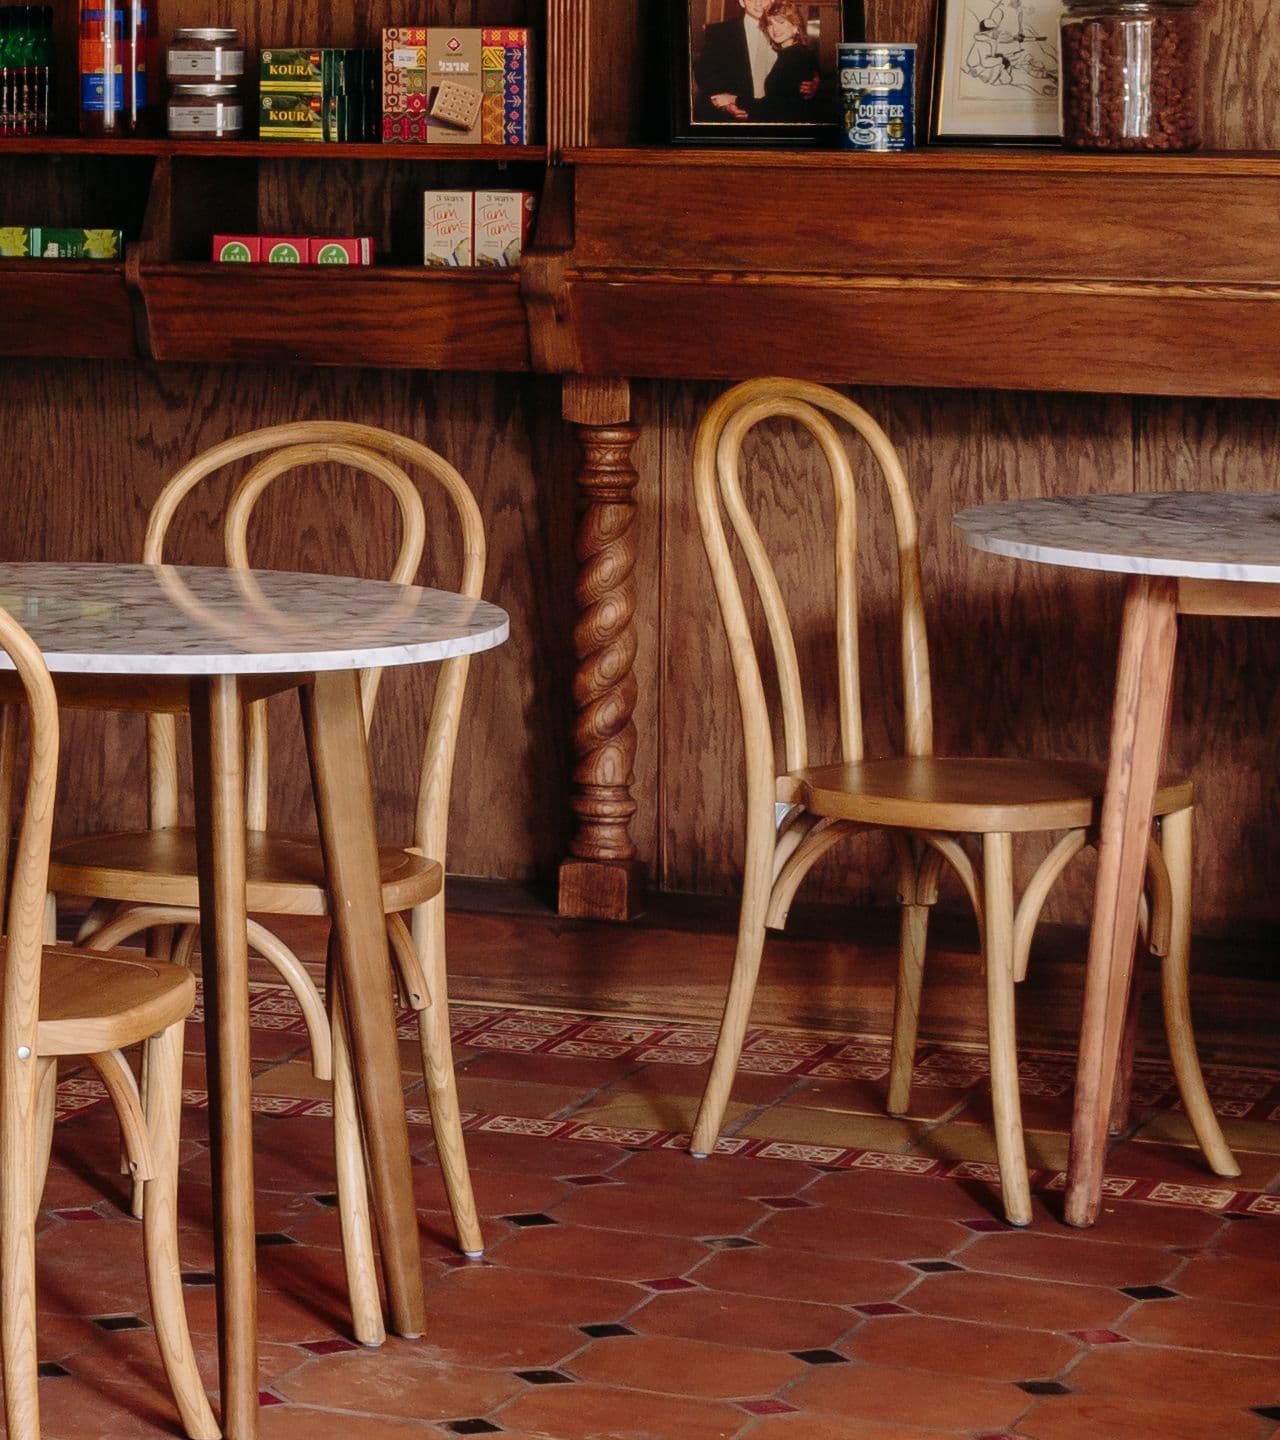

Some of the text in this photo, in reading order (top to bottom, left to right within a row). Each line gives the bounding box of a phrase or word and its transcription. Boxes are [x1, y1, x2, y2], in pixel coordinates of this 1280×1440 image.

[269, 64, 313, 76] KOURA
[843, 70, 900, 85] SAHADI
[269, 110, 314, 122] KOURA
[859, 104, 904, 117] COFFEE
